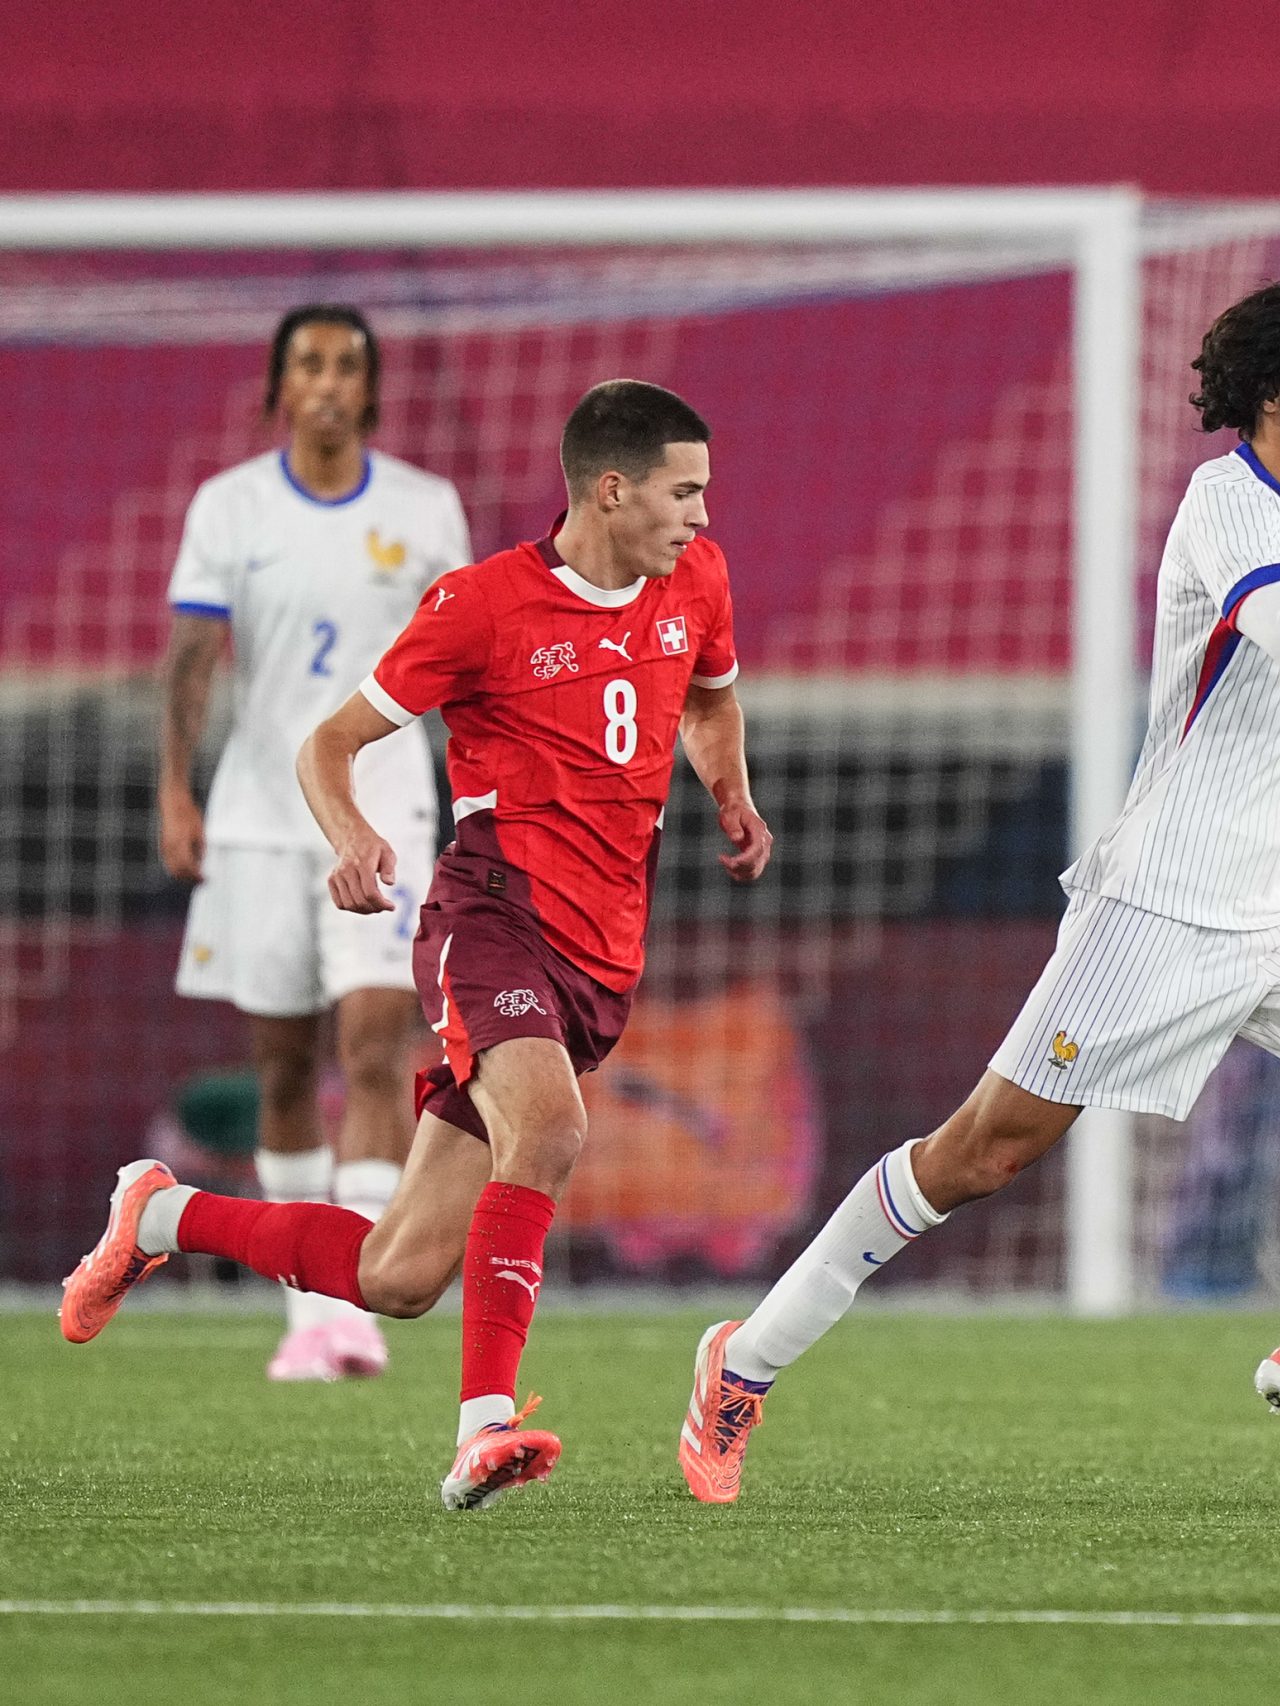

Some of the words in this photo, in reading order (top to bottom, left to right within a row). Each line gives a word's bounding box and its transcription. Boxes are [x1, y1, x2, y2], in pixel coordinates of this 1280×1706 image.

[310, 620, 338, 677] 2
[603, 679, 638, 764] 8
[393, 886, 415, 939] 2
